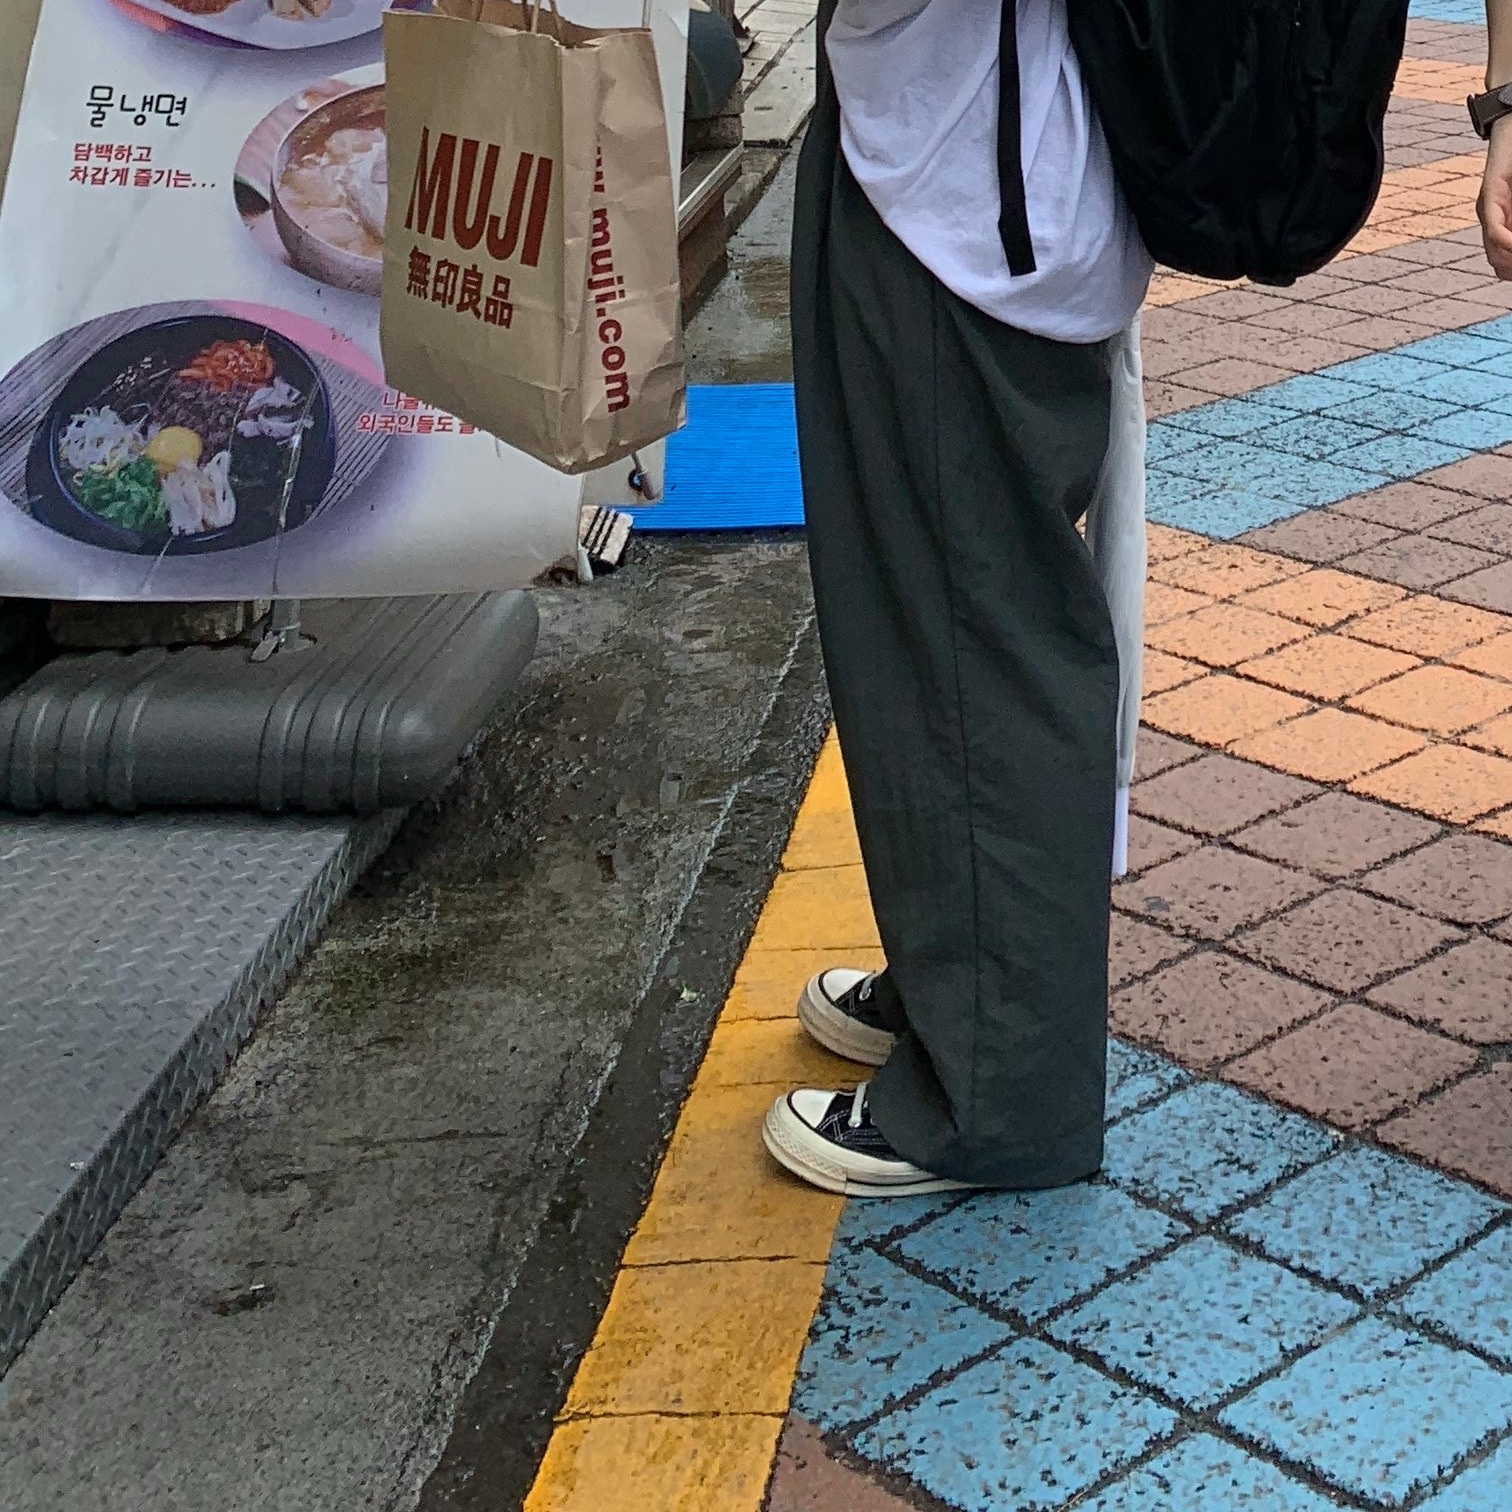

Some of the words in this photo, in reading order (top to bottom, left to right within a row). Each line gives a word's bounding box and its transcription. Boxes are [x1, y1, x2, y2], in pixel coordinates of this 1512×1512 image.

[86, 86, 187, 128] 물냉면
[73, 143, 152, 164] 담백하고
[70, 166, 128, 187] 차갑게
[404, 126, 553, 268] MUJI
[406, 245, 514, 329] 無印良品
[357, 414, 454, 434] 외국인들도
